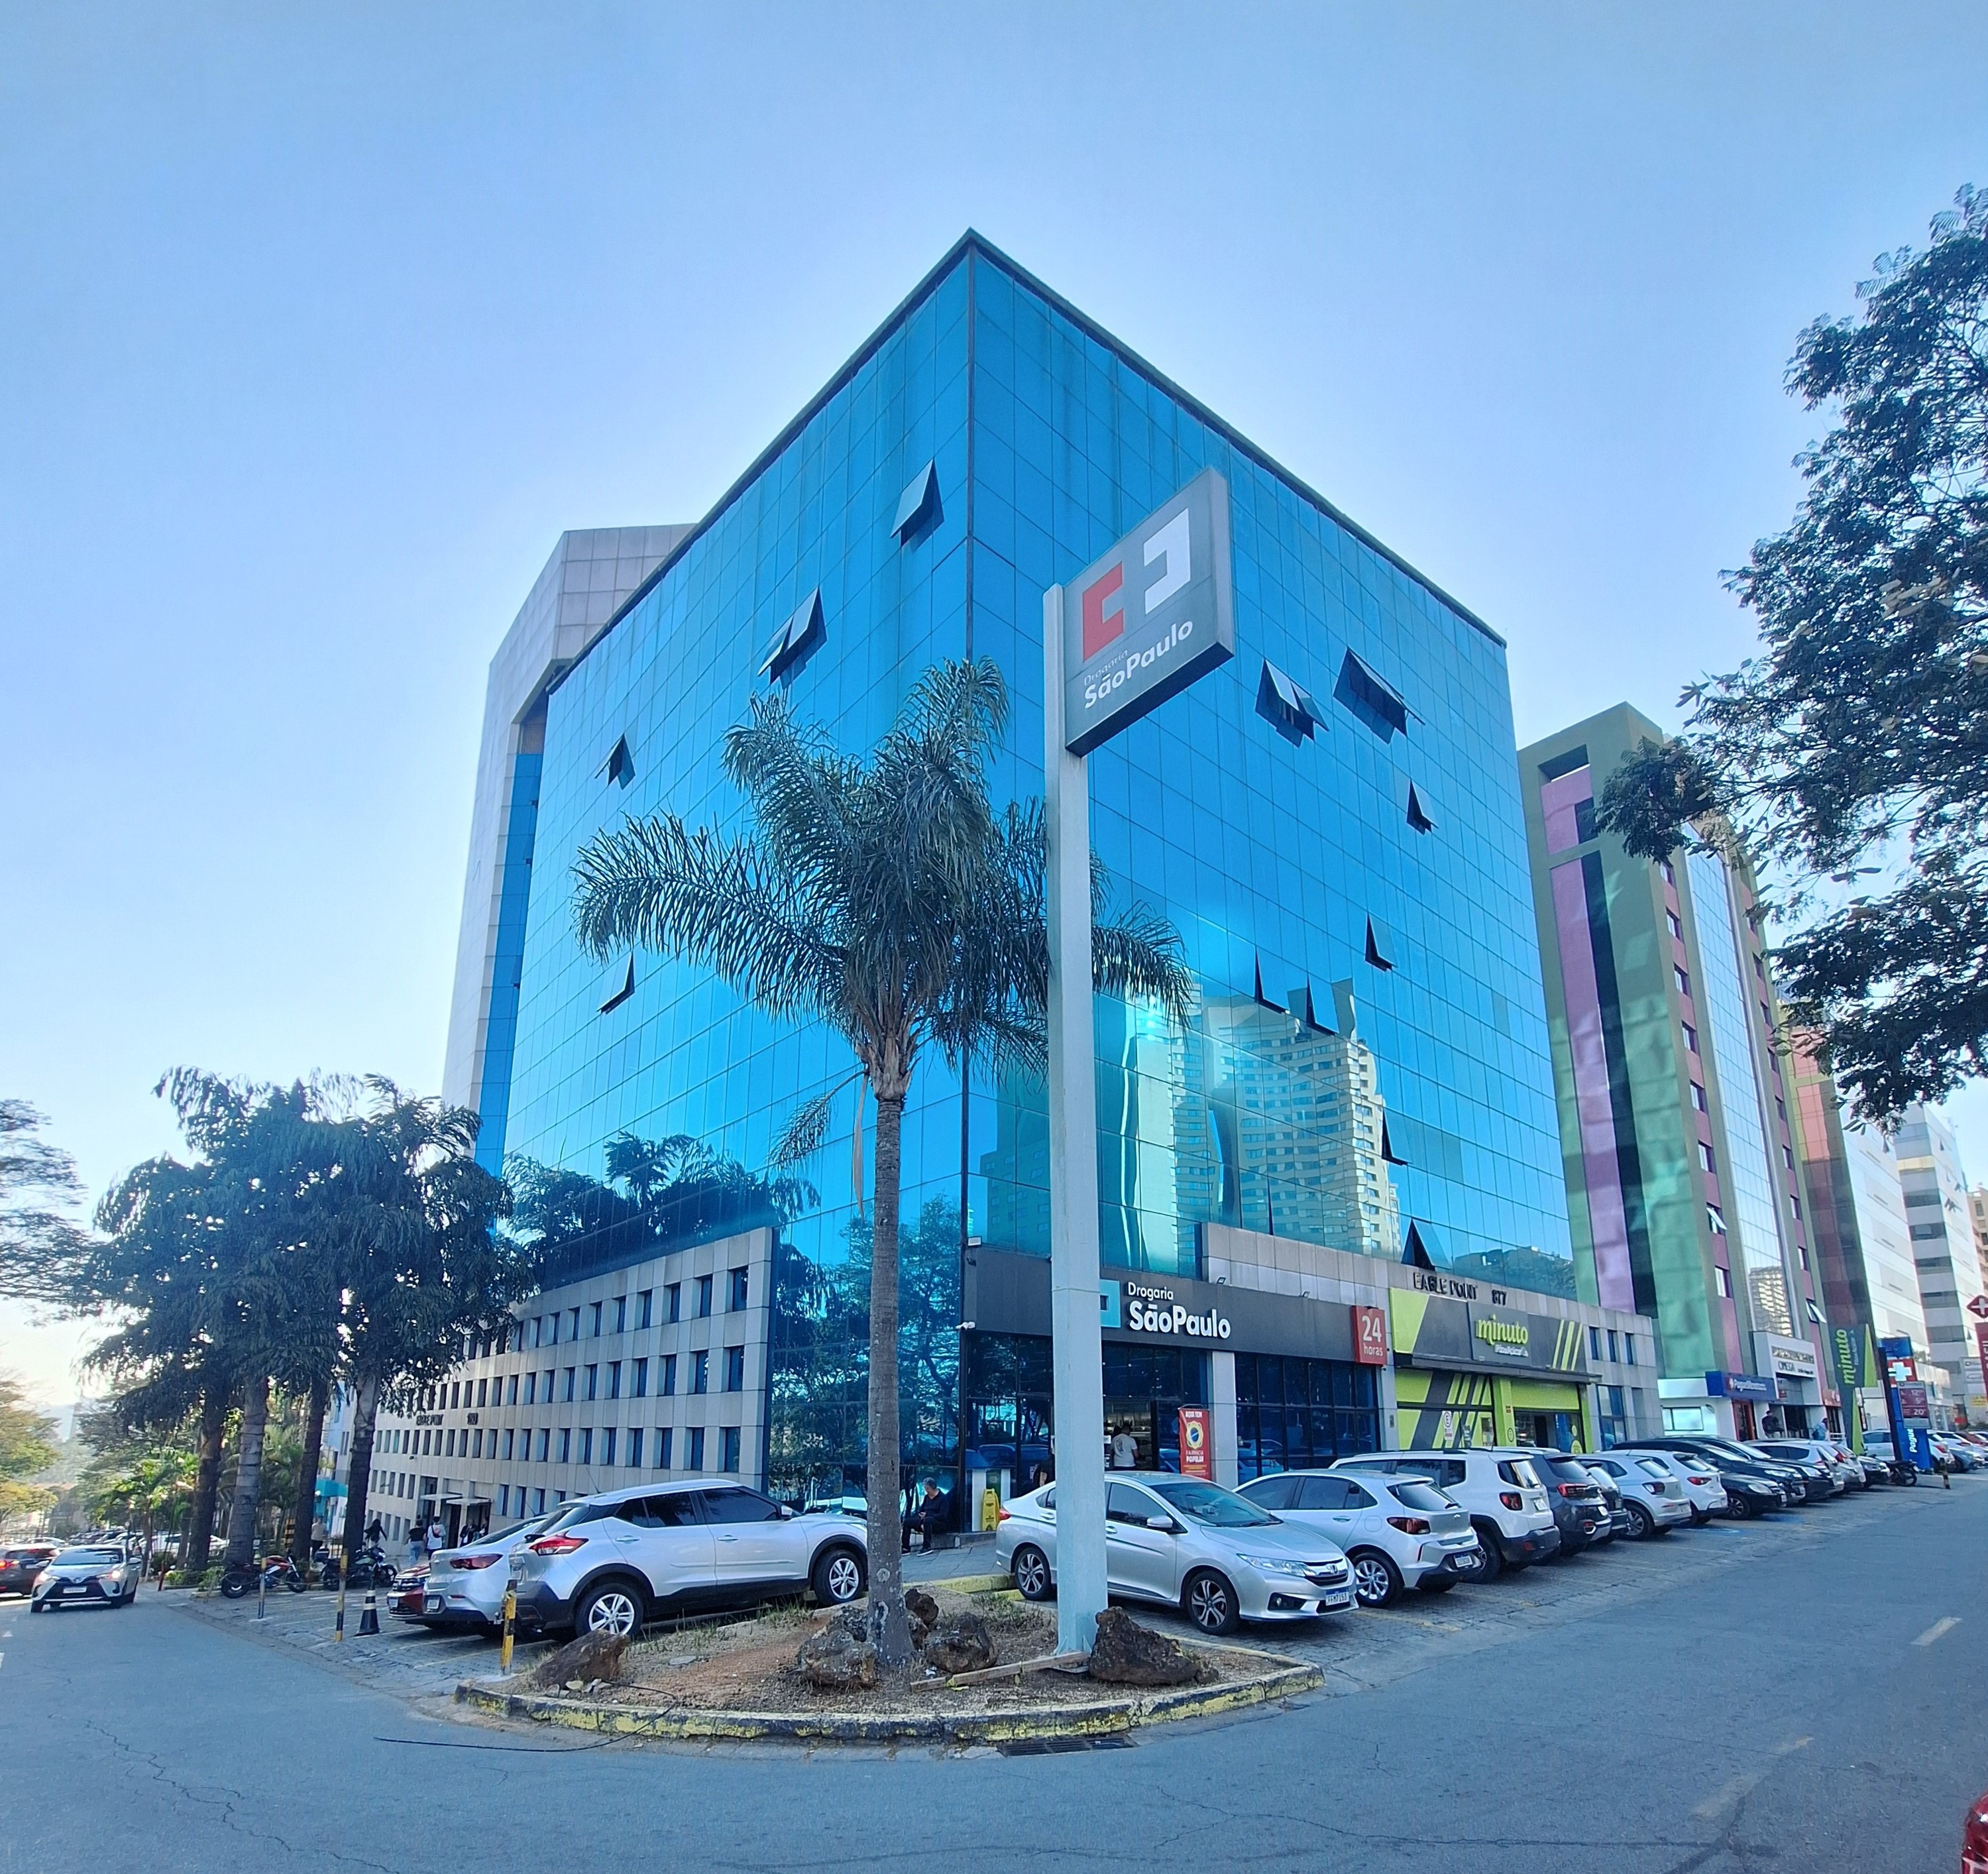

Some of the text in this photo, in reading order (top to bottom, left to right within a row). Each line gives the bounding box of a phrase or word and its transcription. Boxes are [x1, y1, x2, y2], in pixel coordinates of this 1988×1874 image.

[1084, 649, 1128, 686] Drogaria
[1128, 1282, 1174, 1301] Drogaria
[1129, 1300, 1231, 1339] SãoPaulo
[1362, 1315, 1382, 1343] 24
[1475, 1313, 1528, 1346] minuto
[1363, 1343, 1383, 1356] horas
[1834, 1329, 1856, 1384] minuto
